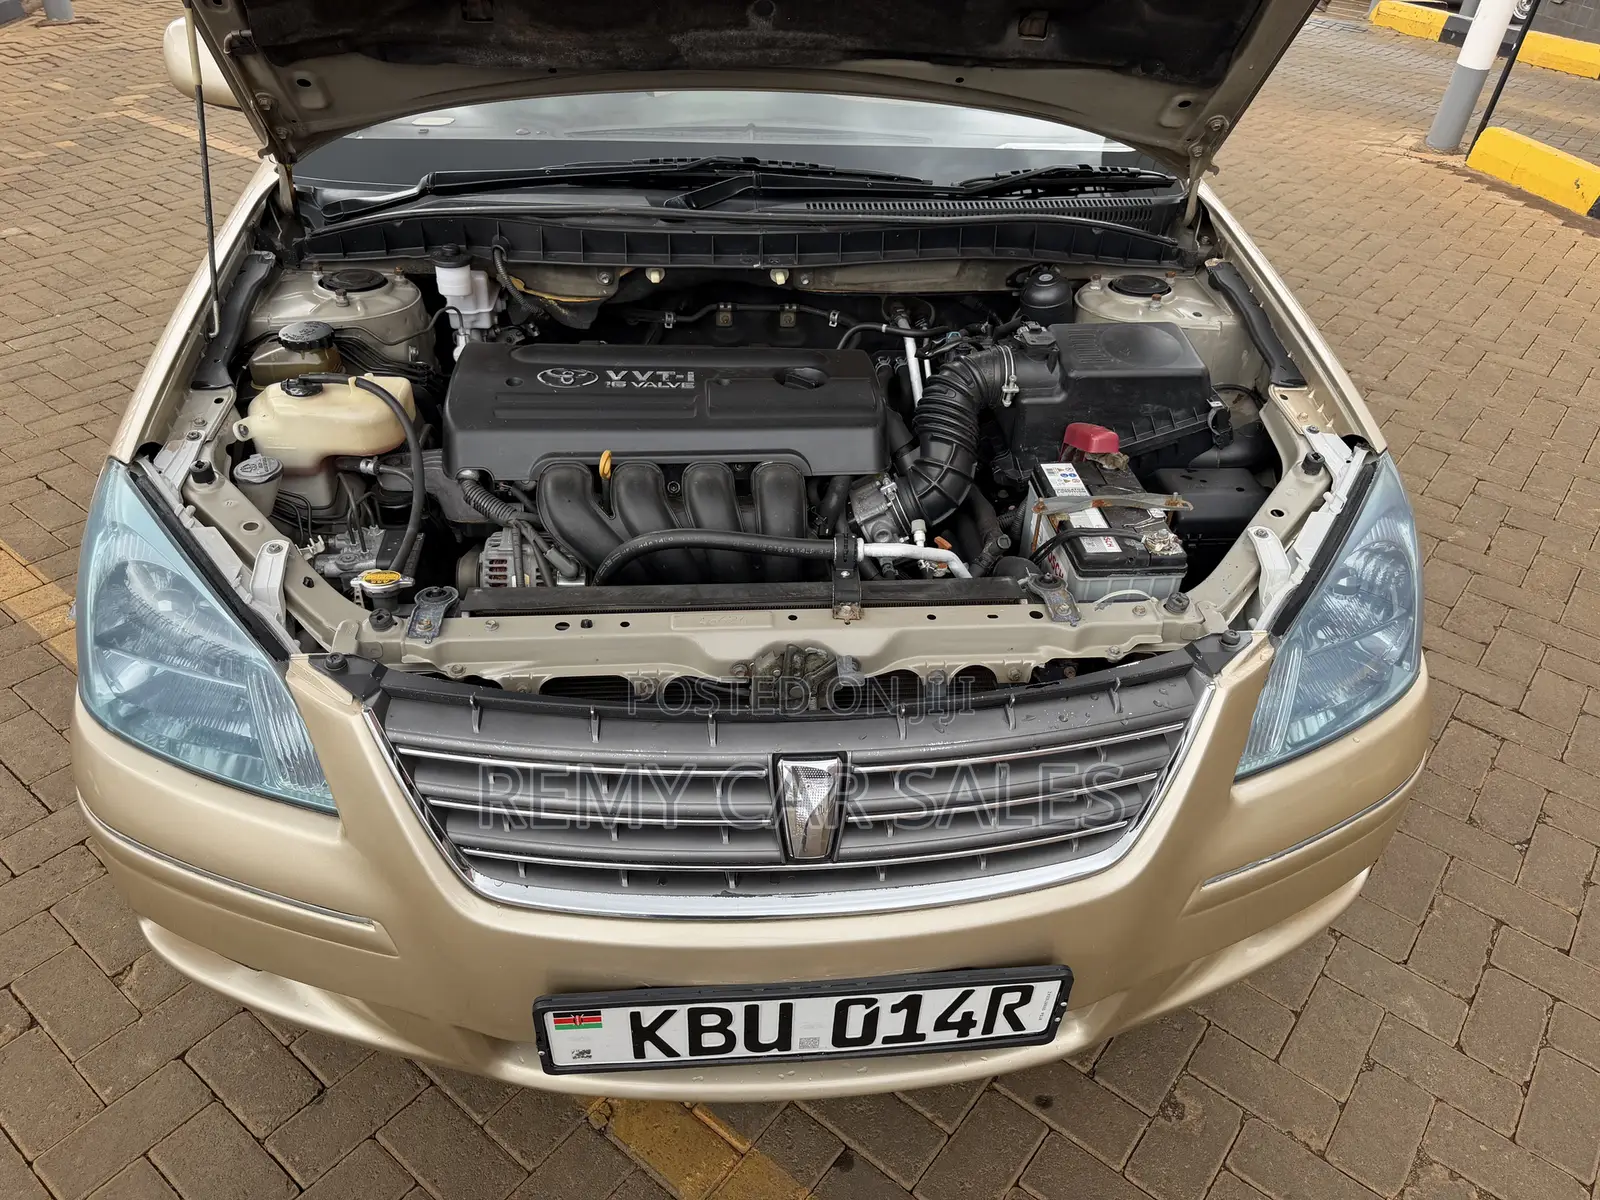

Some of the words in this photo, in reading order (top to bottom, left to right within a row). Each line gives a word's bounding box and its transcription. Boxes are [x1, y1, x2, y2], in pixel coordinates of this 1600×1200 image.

[631, 381, 695, 389] VALVE
[630, 1003, 793, 1059] KBU
[832, 985, 1034, 1048] 014R
